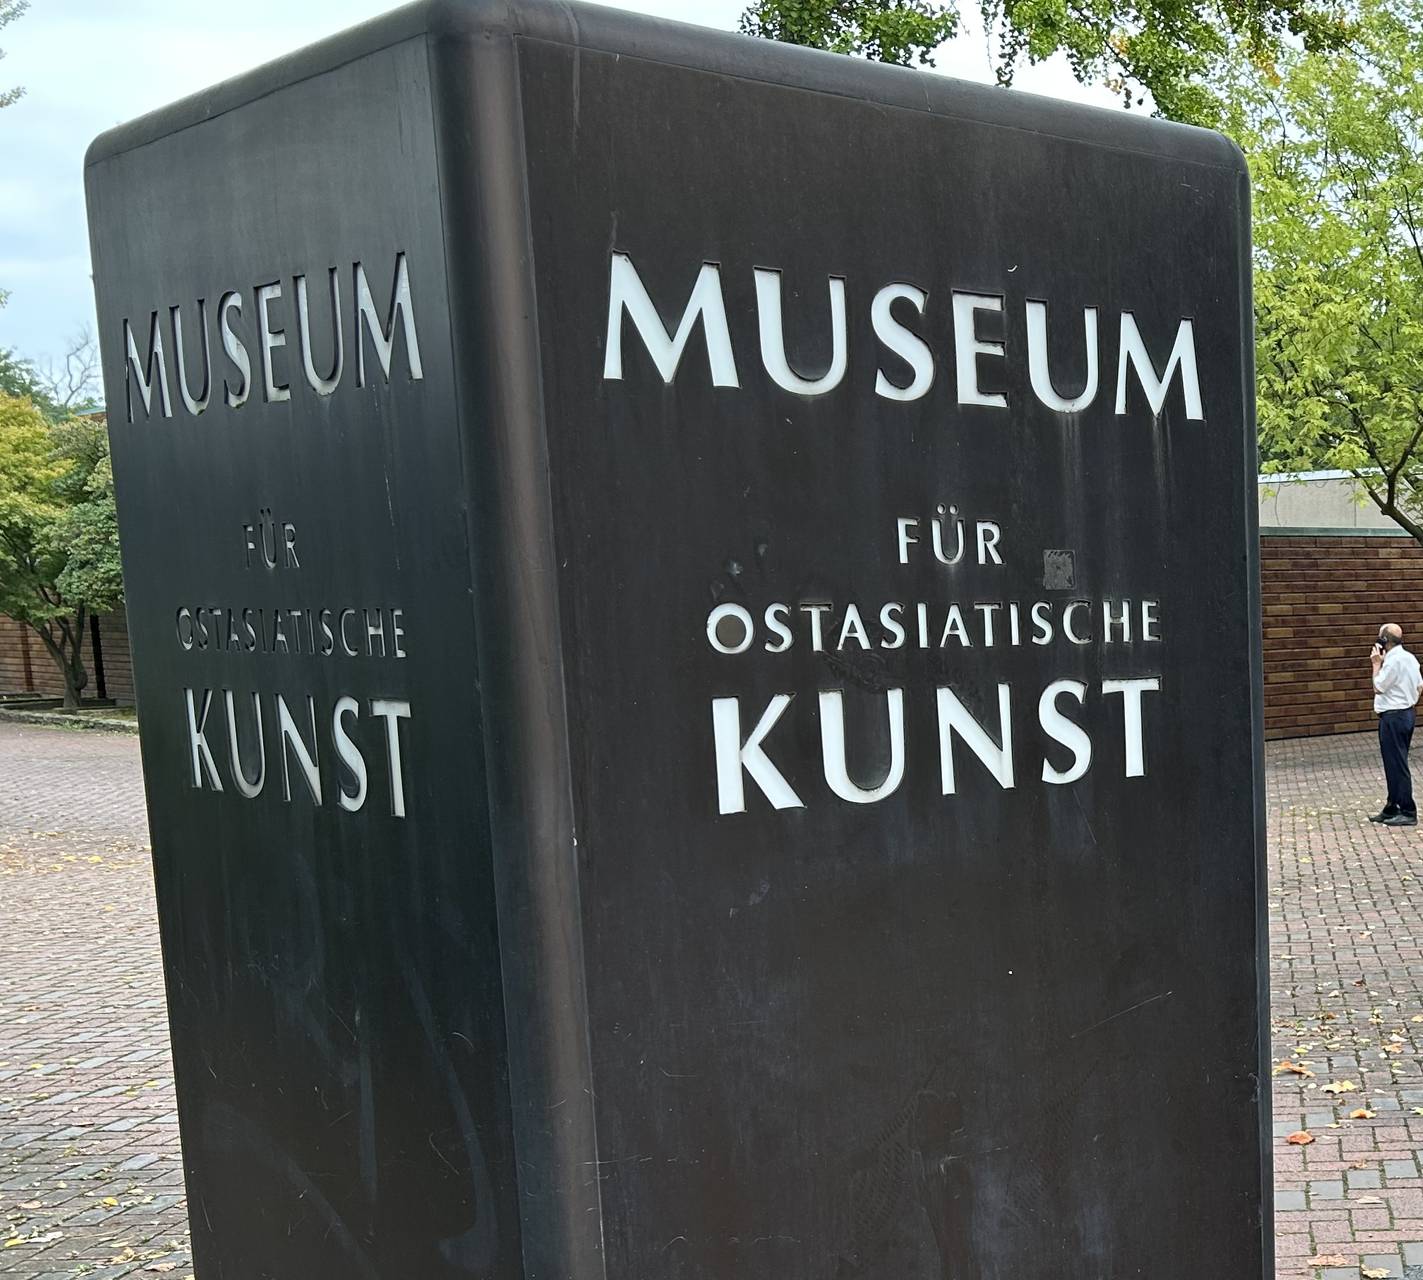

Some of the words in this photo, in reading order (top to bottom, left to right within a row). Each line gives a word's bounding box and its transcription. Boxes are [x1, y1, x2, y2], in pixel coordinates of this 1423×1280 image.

[122, 250, 424, 424] MUSEUM
[603, 249, 1206, 422] MUSEUM
[242, 508, 300, 570] FÜR
[896, 503, 1006, 566] FÜR
[175, 606, 407, 658] OSTASIATISCHE
[705, 599, 1162, 655] OSTASIATISCHE
[184, 687, 413, 818] KUNST
[710, 675, 1162, 815] KUNST
